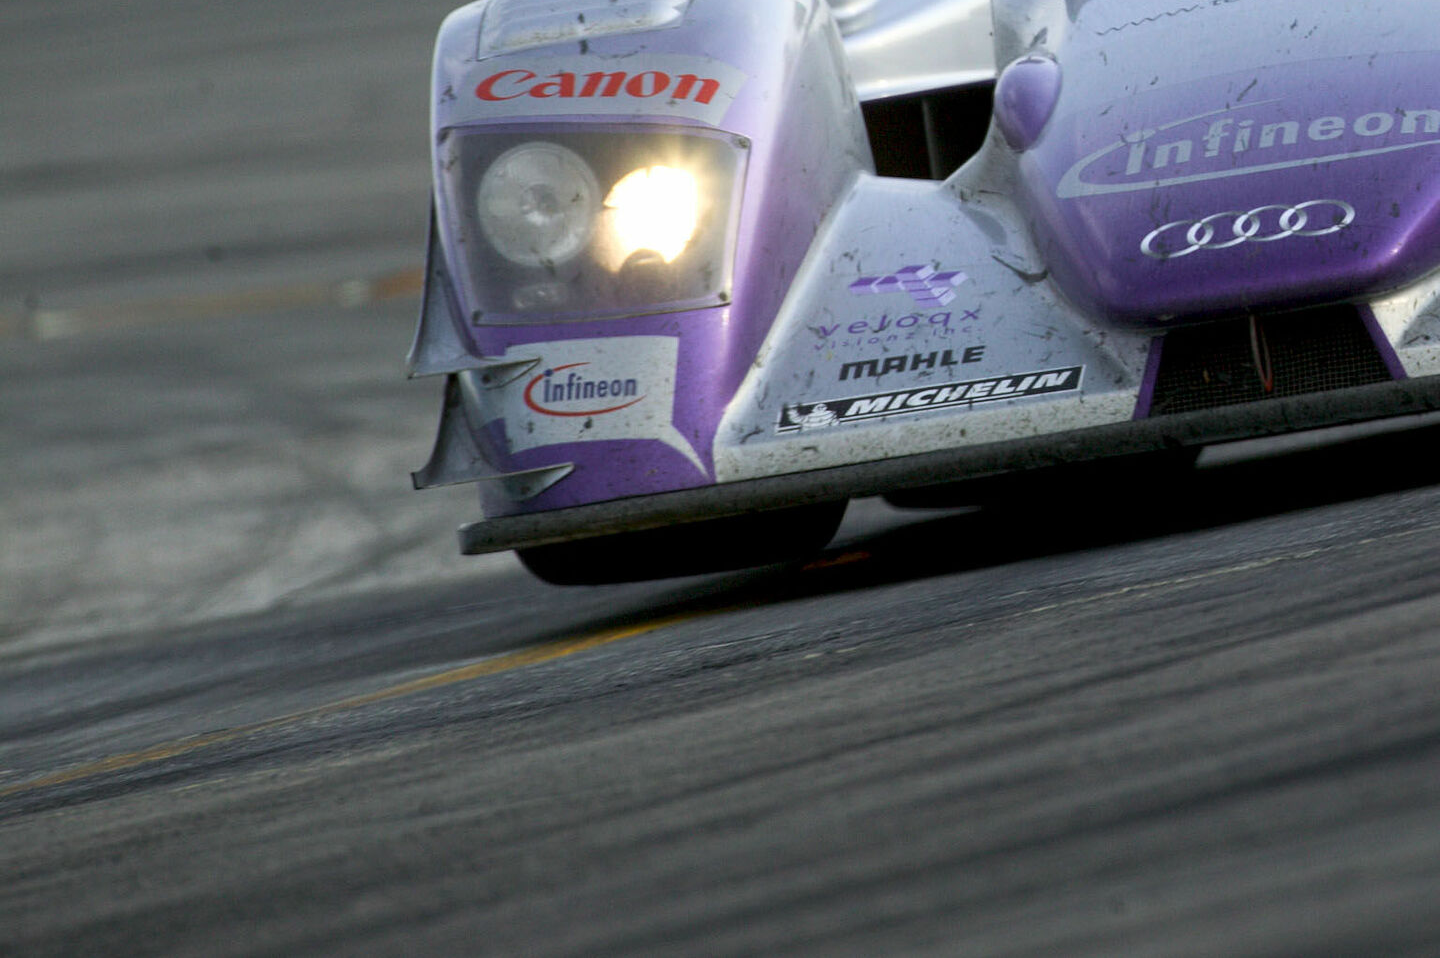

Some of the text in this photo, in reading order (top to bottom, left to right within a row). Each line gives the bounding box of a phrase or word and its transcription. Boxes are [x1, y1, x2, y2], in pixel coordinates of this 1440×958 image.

[475, 68, 721, 105] Canon
[820, 309, 979, 337] veloqx
[838, 346, 986, 381] MAHLE
[844, 371, 1071, 416] MICHELIN
